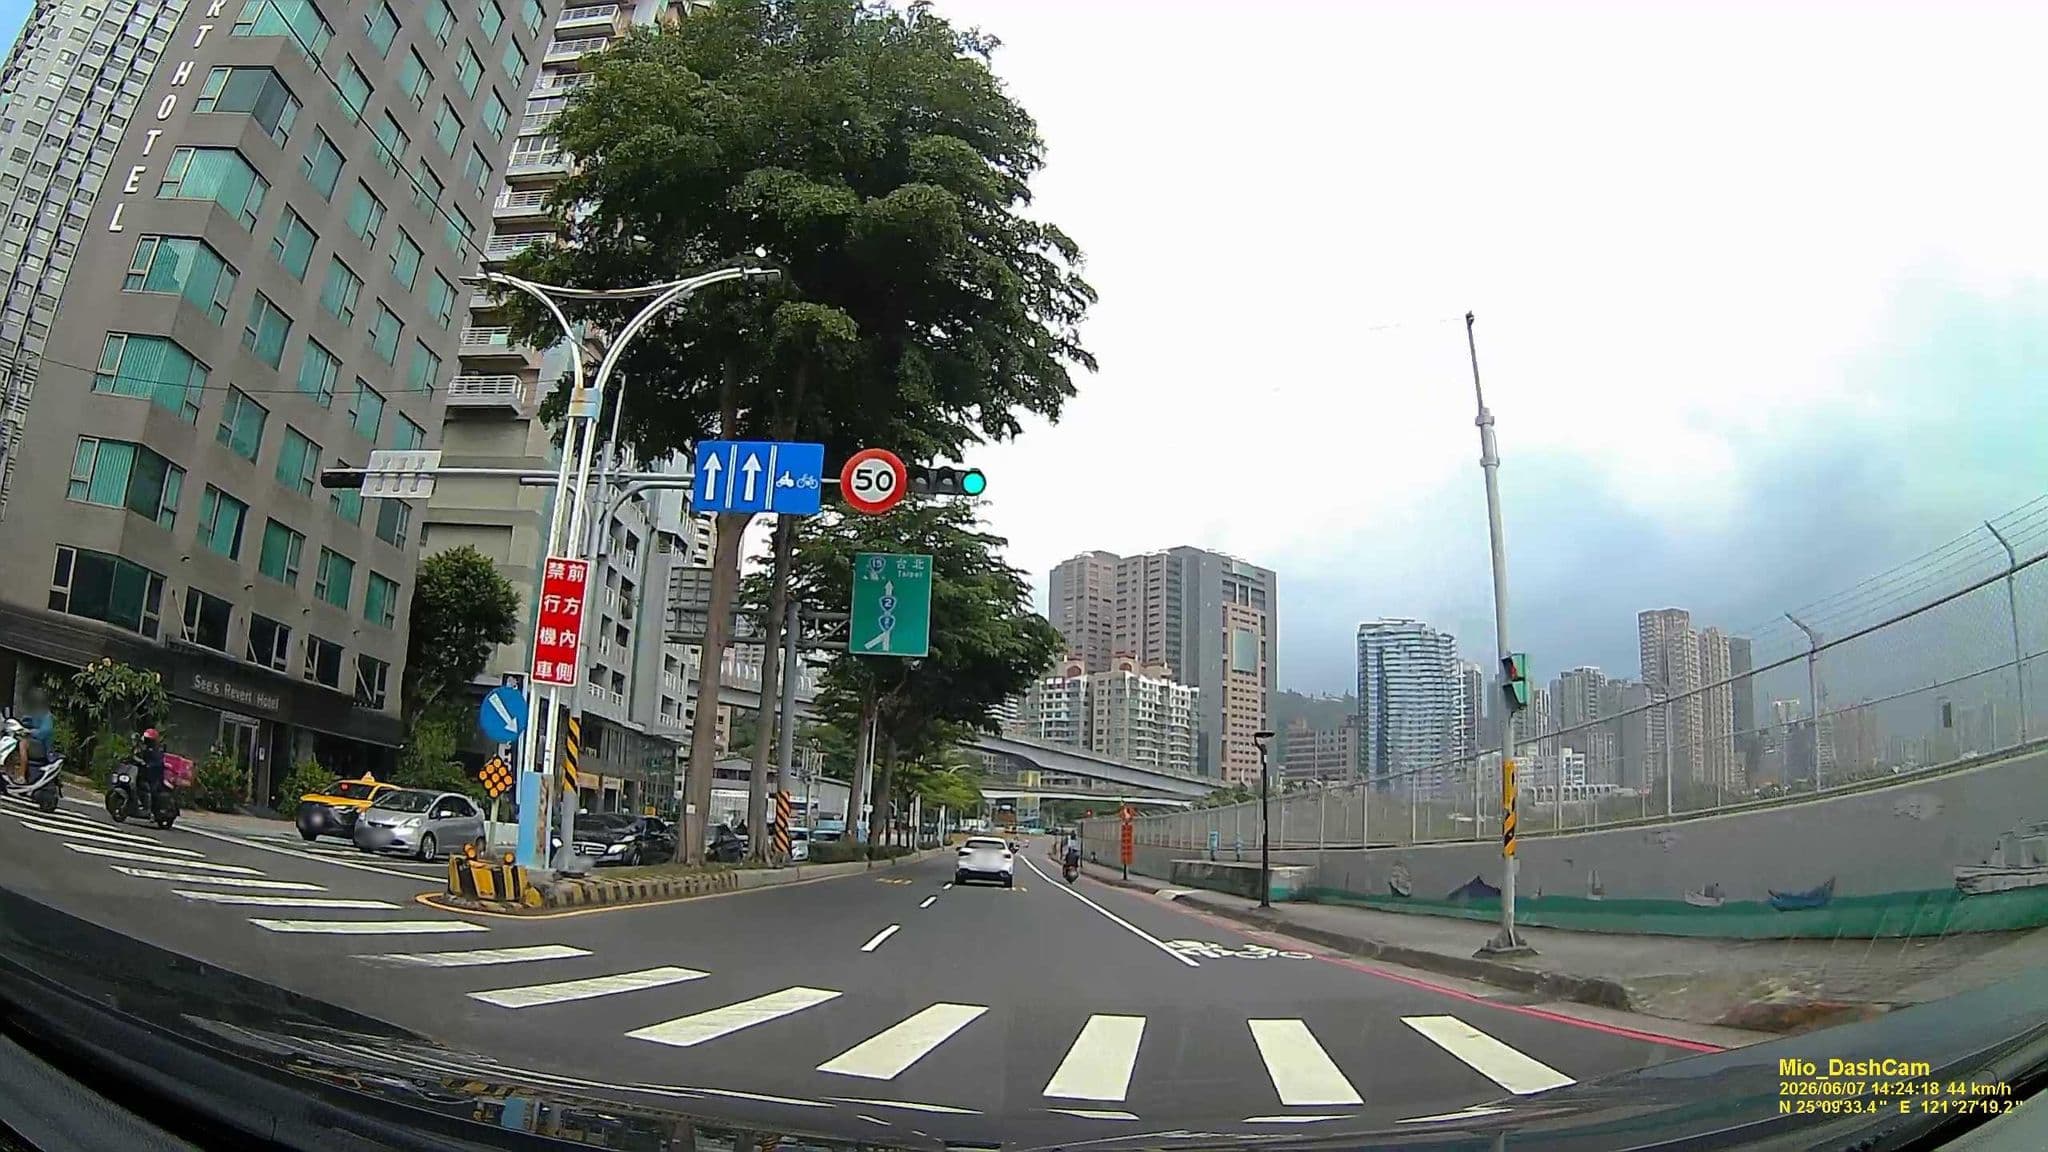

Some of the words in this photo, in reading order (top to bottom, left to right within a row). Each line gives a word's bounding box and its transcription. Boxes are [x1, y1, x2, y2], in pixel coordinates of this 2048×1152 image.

[108, 61, 195, 232] HOTEL
[855, 468, 893, 492] 50
[896, 558, 925, 570] 台北
[884, 598, 892, 608] 2
[535, 562, 565, 679] 禁行機車
